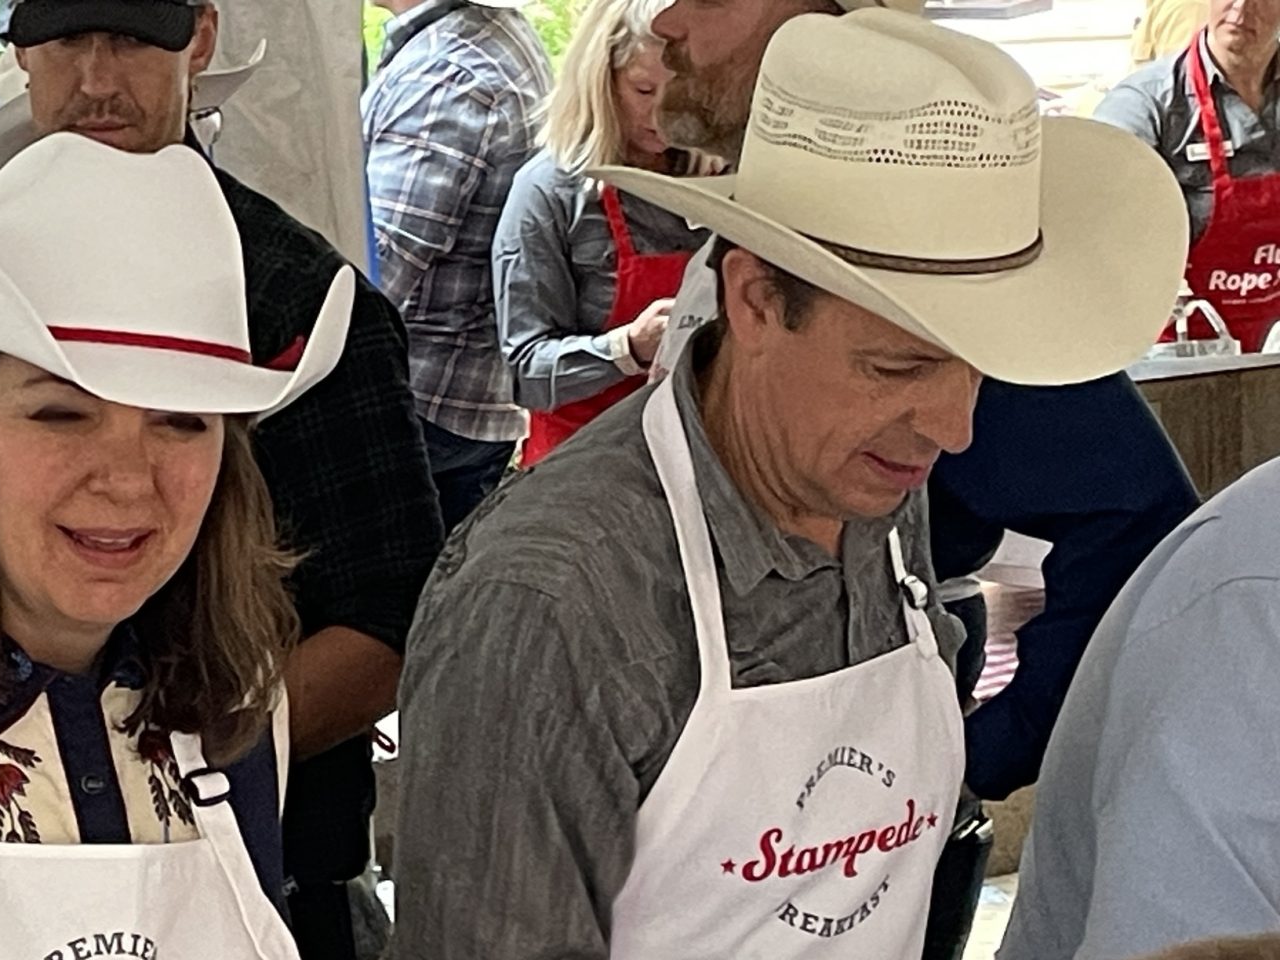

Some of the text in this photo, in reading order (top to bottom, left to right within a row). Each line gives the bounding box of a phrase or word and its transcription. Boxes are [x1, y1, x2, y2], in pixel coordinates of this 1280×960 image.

[1208, 269, 1273, 297] Rope
[741, 798, 925, 882] Stampede
[775, 874, 890, 938] REAKFAST
